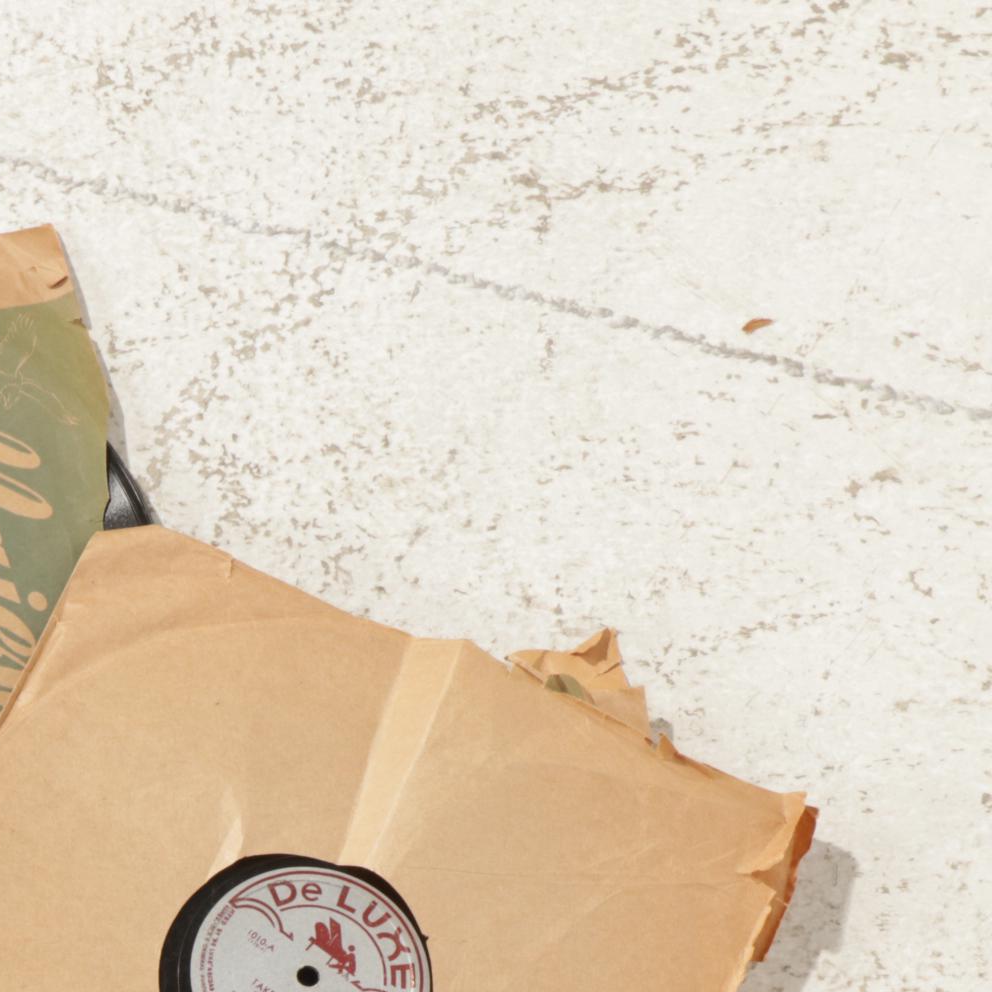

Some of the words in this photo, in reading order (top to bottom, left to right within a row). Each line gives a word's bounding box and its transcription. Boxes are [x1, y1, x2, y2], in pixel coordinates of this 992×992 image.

[247, 929, 275, 952] 1010-A
[267, 880, 323, 907] De
[336, 885, 416, 989] LUXE
